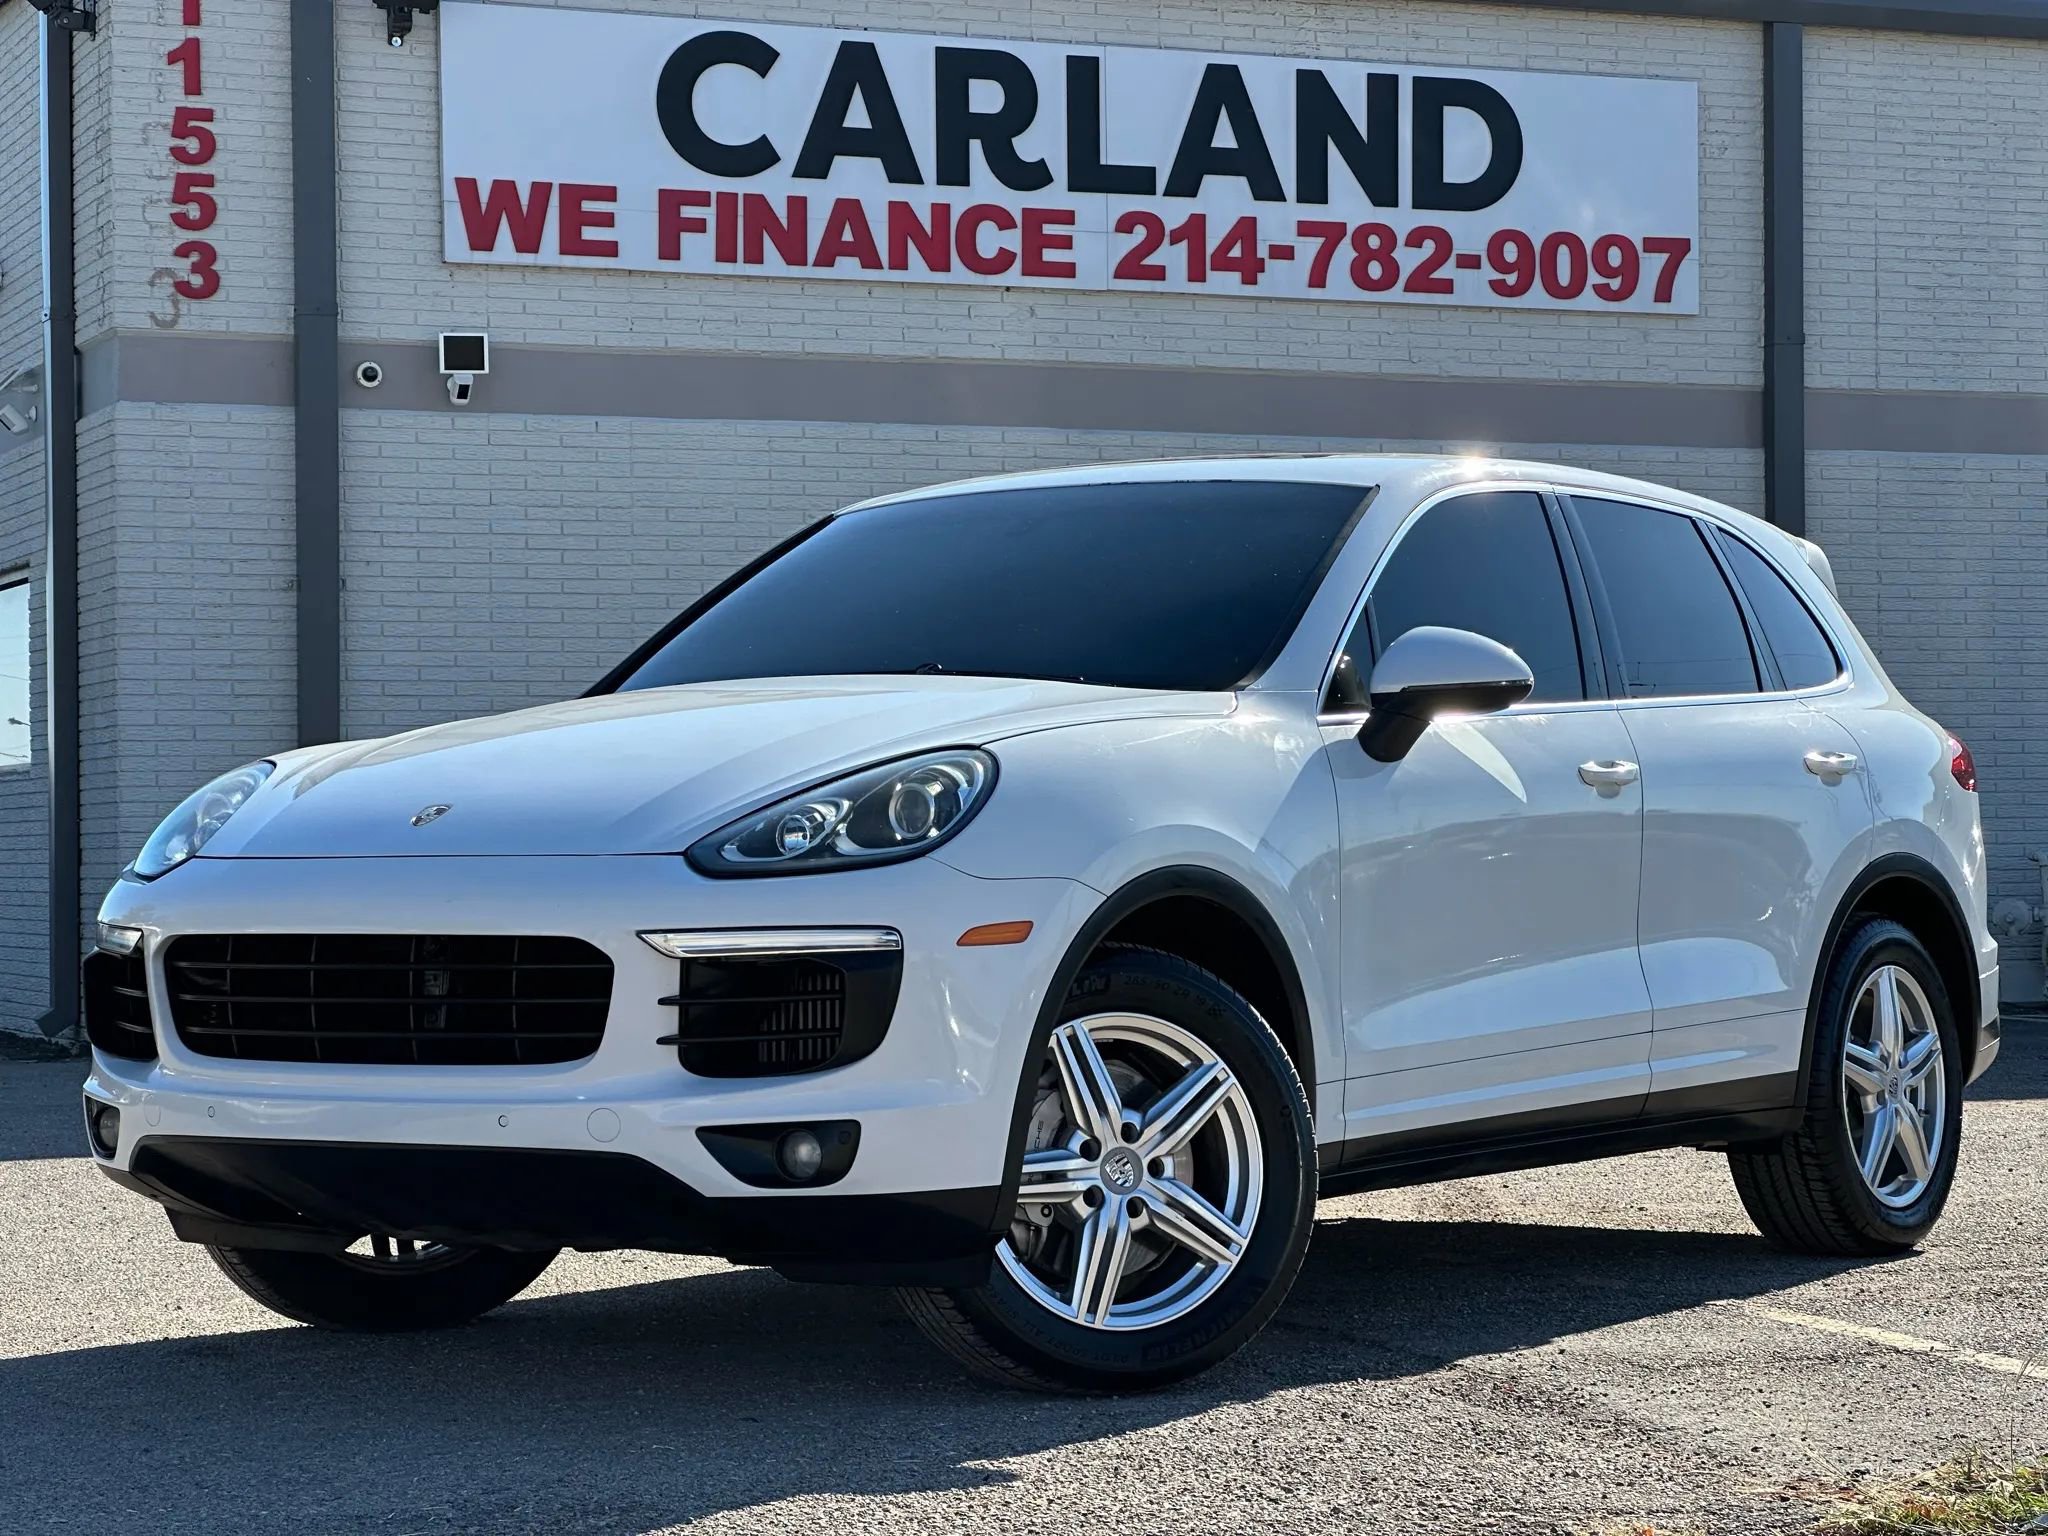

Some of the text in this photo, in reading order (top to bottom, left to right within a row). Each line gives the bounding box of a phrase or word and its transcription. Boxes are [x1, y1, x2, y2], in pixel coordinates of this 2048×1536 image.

[656, 30, 1524, 212] CARLAND
[455, 177, 1690, 302] WE FINANCE 214-782-9097
